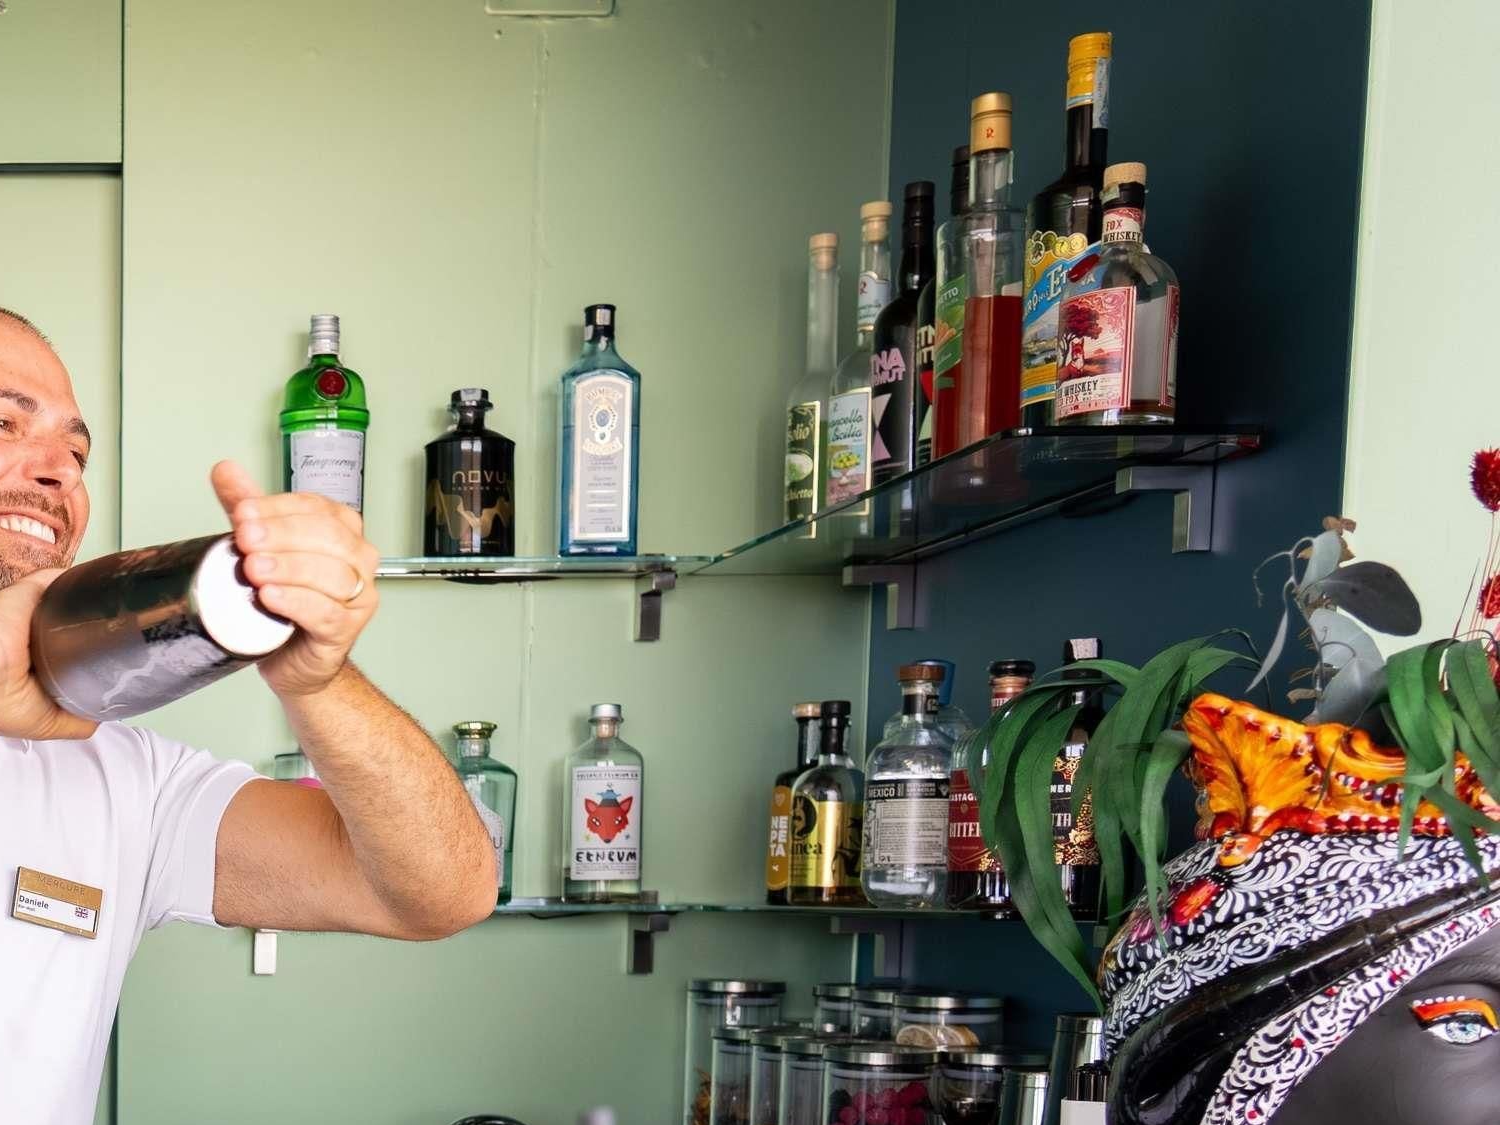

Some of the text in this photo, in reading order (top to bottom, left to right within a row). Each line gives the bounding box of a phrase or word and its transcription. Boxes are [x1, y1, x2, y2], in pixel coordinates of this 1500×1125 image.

[1106, 219, 1123, 231] FOX
[1104, 231, 1142, 243] WHISKEY
[1064, 380, 1099, 397] WHISKEY
[868, 787, 895, 798] MEXICO
[37, 874, 86, 896] MERCURE
[19, 895, 50, 910] Daniele
